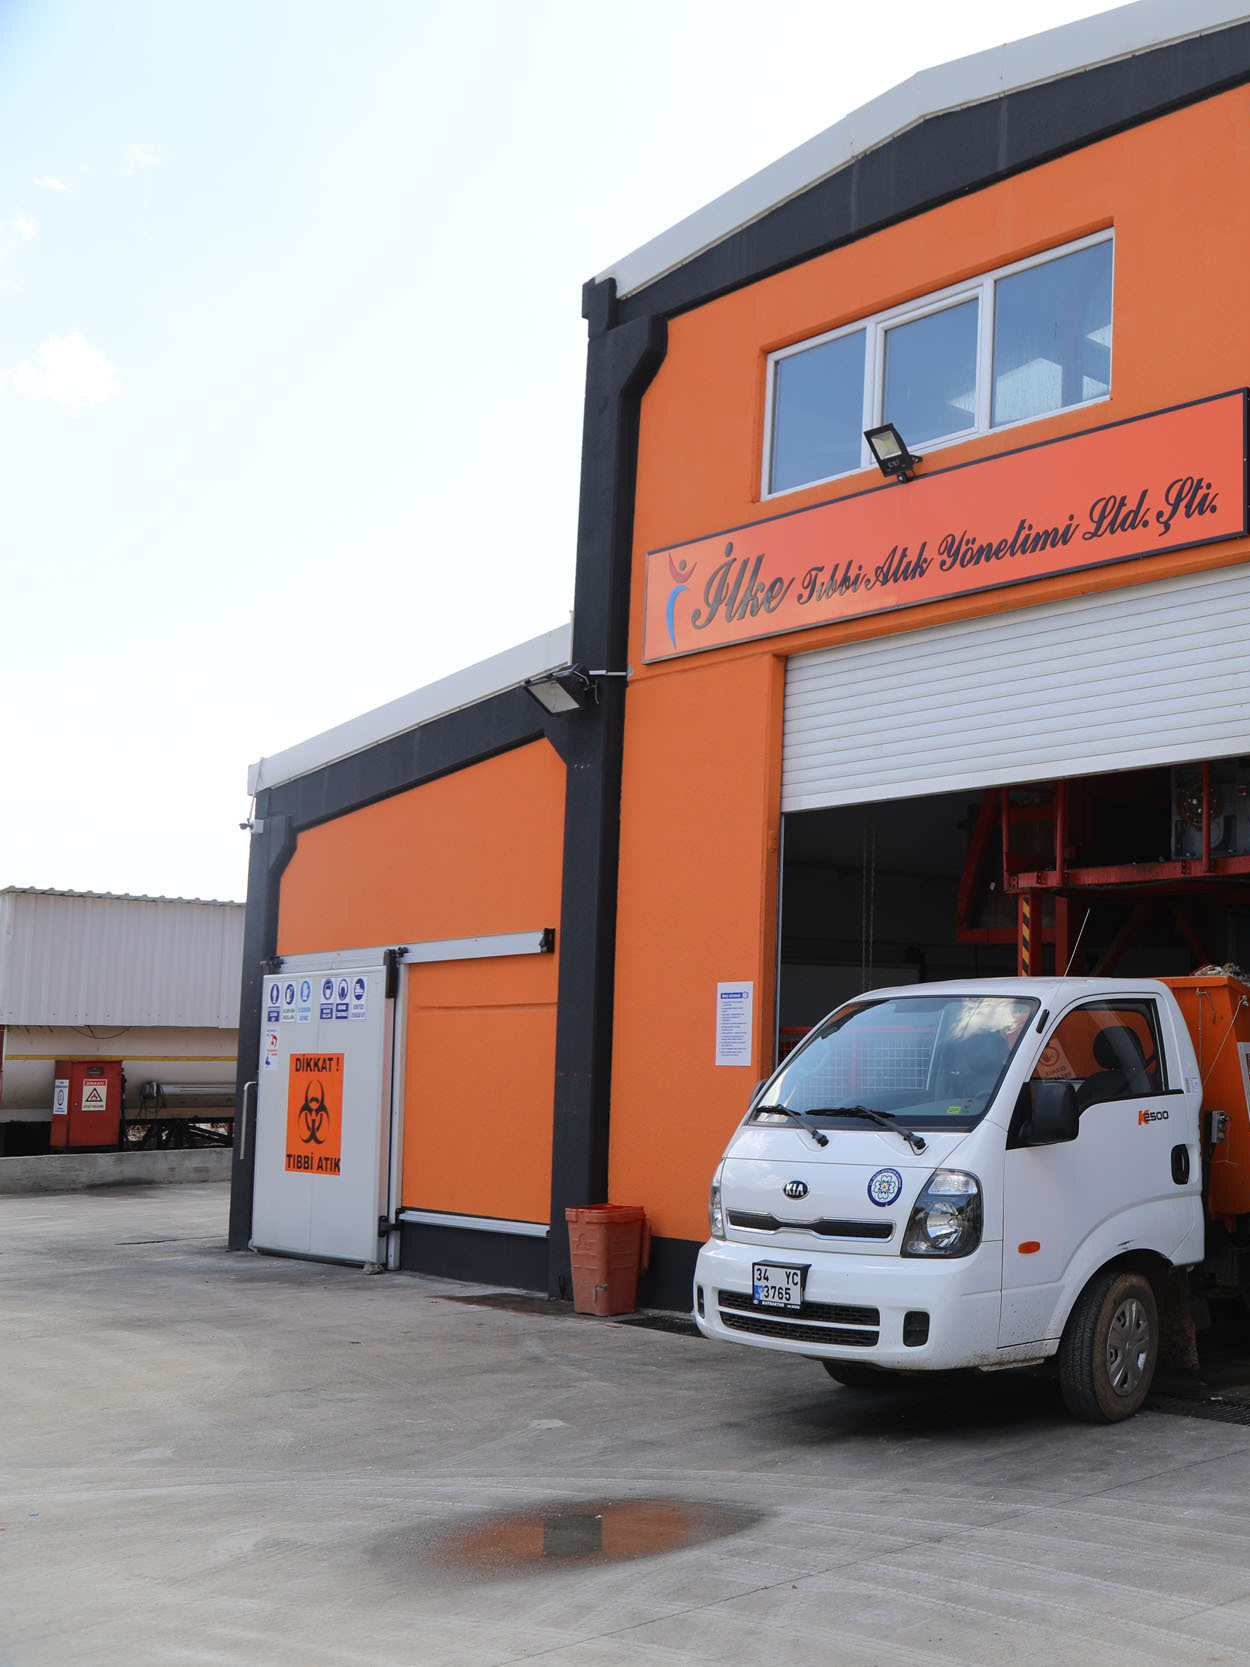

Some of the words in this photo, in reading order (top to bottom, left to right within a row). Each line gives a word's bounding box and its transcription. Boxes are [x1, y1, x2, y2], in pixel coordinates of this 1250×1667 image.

[691, 541, 796, 630] İlke
[797, 560, 867, 604] Tıbbi
[864, 541, 934, 591] Atık
[938, 514, 1080, 572] Yönetimi
[1082, 489, 1151, 541] Ltd.
[1155, 476, 1219, 537] Şti.
[295, 1054, 334, 1072] DİKKAT
[286, 1152, 314, 1170] TIBBİ
[316, 1156, 341, 1173] ATIK
[785, 1183, 804, 1196] KIA
[756, 1267, 769, 1282] 34
[785, 1271, 799, 1286] YC
[763, 1285, 791, 1301] 3765
